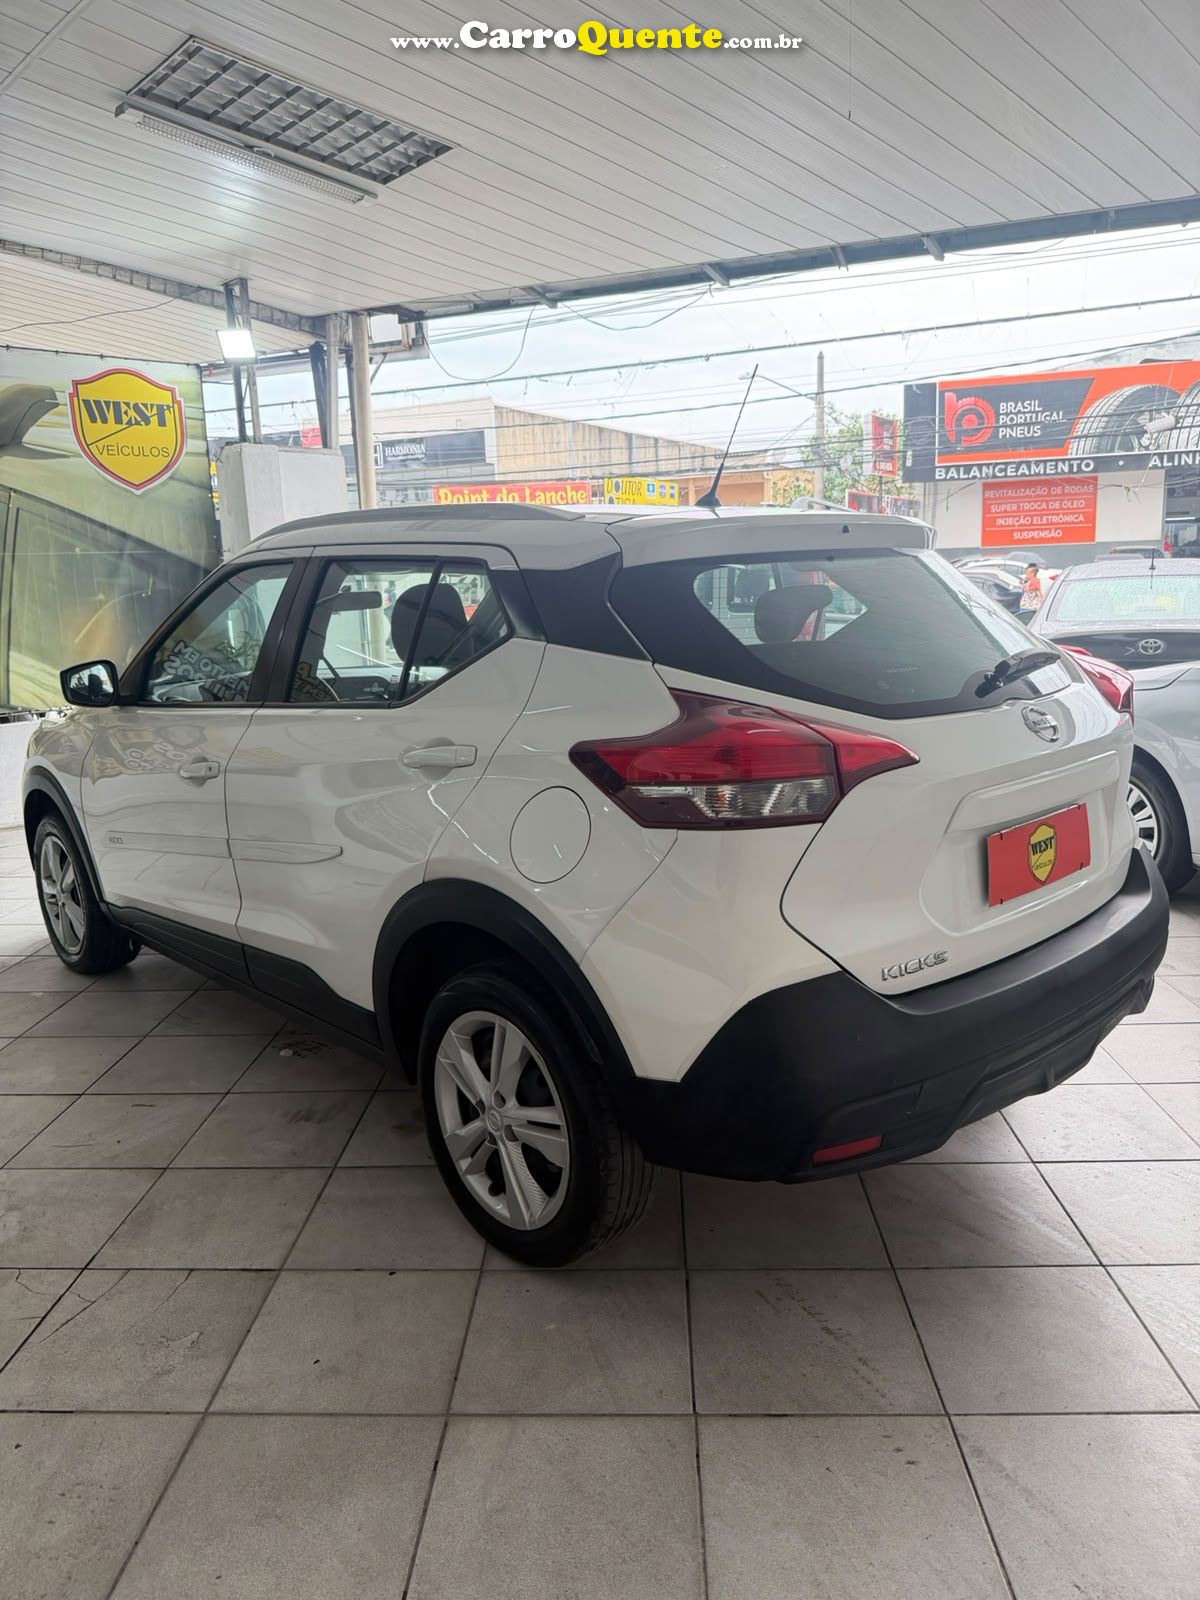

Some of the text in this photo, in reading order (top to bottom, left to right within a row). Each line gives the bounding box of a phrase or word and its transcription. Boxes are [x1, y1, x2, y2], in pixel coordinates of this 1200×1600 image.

[81, 398, 173, 428] WEST
[999, 400, 1043, 414] BRASIL
[999, 411, 1067, 426] PORTUGAL
[999, 426, 1041, 439] PNEUS
[96, 442, 170, 458] VEÍCULOS
[384, 443, 426, 457] HARMONIA
[935, 459, 1094, 480] BALANCEAMENTO
[525, 483, 586, 505] Lanche
[984, 484, 1094, 498] REVITALIZAÇÃO DE RODAS
[990, 499, 1085, 513] SUPER TROCA DE ÓLEO
[995, 513, 1085, 527] INJEÇÃO ELETRÔNICA
[1013, 528, 1063, 540] SUSPENSÃO
[1031, 836, 1055, 857] WEST
[881, 950, 949, 982] KICKS
